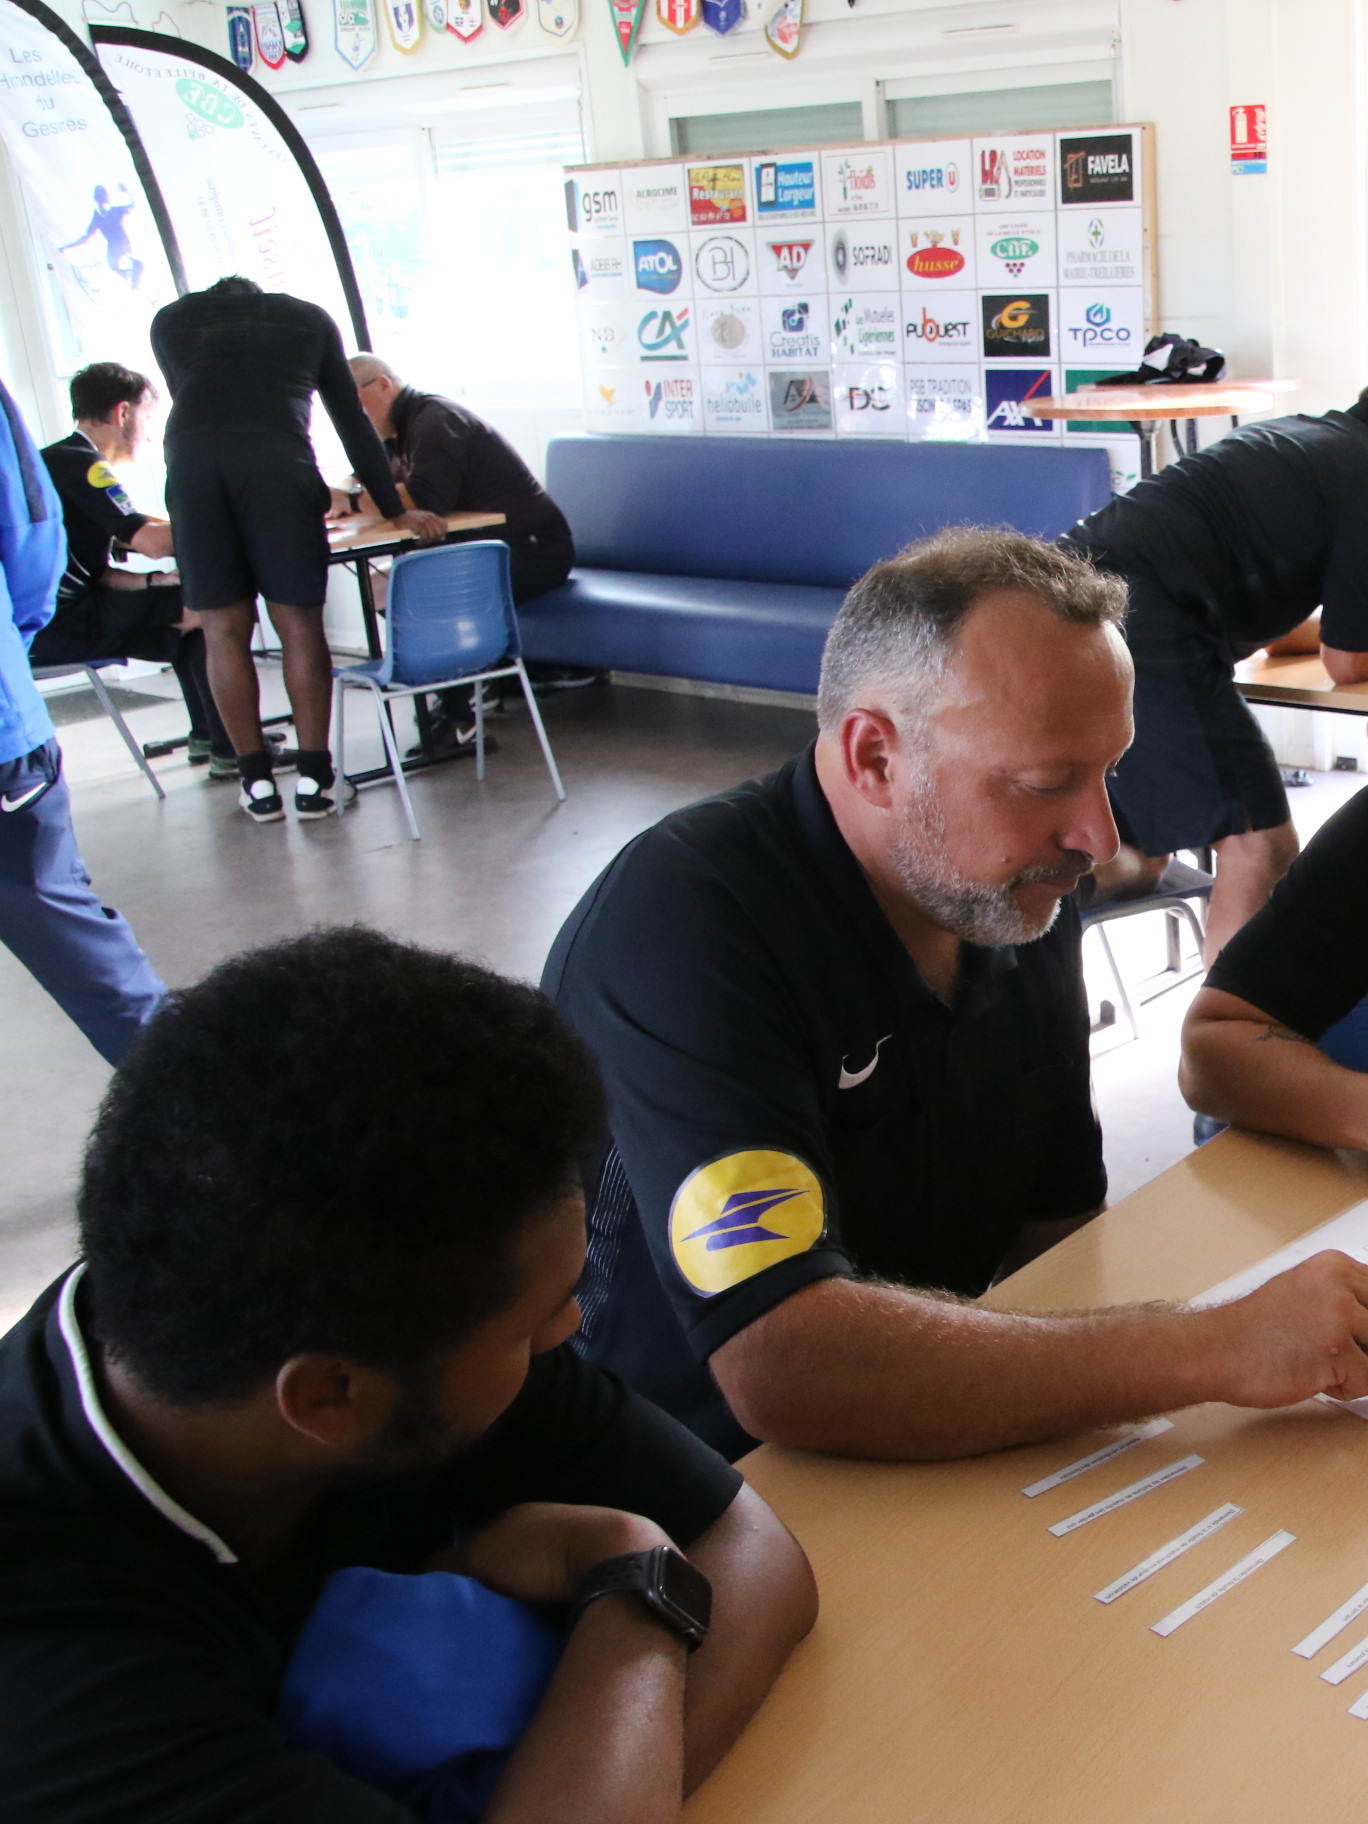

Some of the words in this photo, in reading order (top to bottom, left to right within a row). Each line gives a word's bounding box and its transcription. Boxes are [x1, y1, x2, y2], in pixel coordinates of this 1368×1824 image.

[9, 47, 42, 63] Les
[1013, 150, 1046, 161] LOCATION
[1087, 154, 1130, 175] FAVELA
[777, 168, 813, 186] Hauteur
[907, 168, 944, 191] SUPER
[948, 170, 956, 187] U
[692, 187, 743, 200] Restaurant
[778, 185, 814, 206] Largeur
[582, 190, 618, 222] gsm
[778, 244, 807, 264] AD
[996, 240, 1032, 258] CBE
[638, 251, 678, 274] ATOL
[913, 253, 960, 272] husse
[986, 328, 1045, 340] GUICHARD
[1068, 328, 1131, 348] TPCO
[772, 347, 818, 358] HABITAT
[663, 379, 693, 398] INTER
[928, 378, 972, 395] TRADITION
[666, 401, 694, 419] SPORT
[1186, 1531, 1203, 1543] feuille
[1104, 1581, 1131, 1600] validation
[1216, 1580, 1234, 1592] feuille
[1345, 1651, 1366, 1667] joueurs
